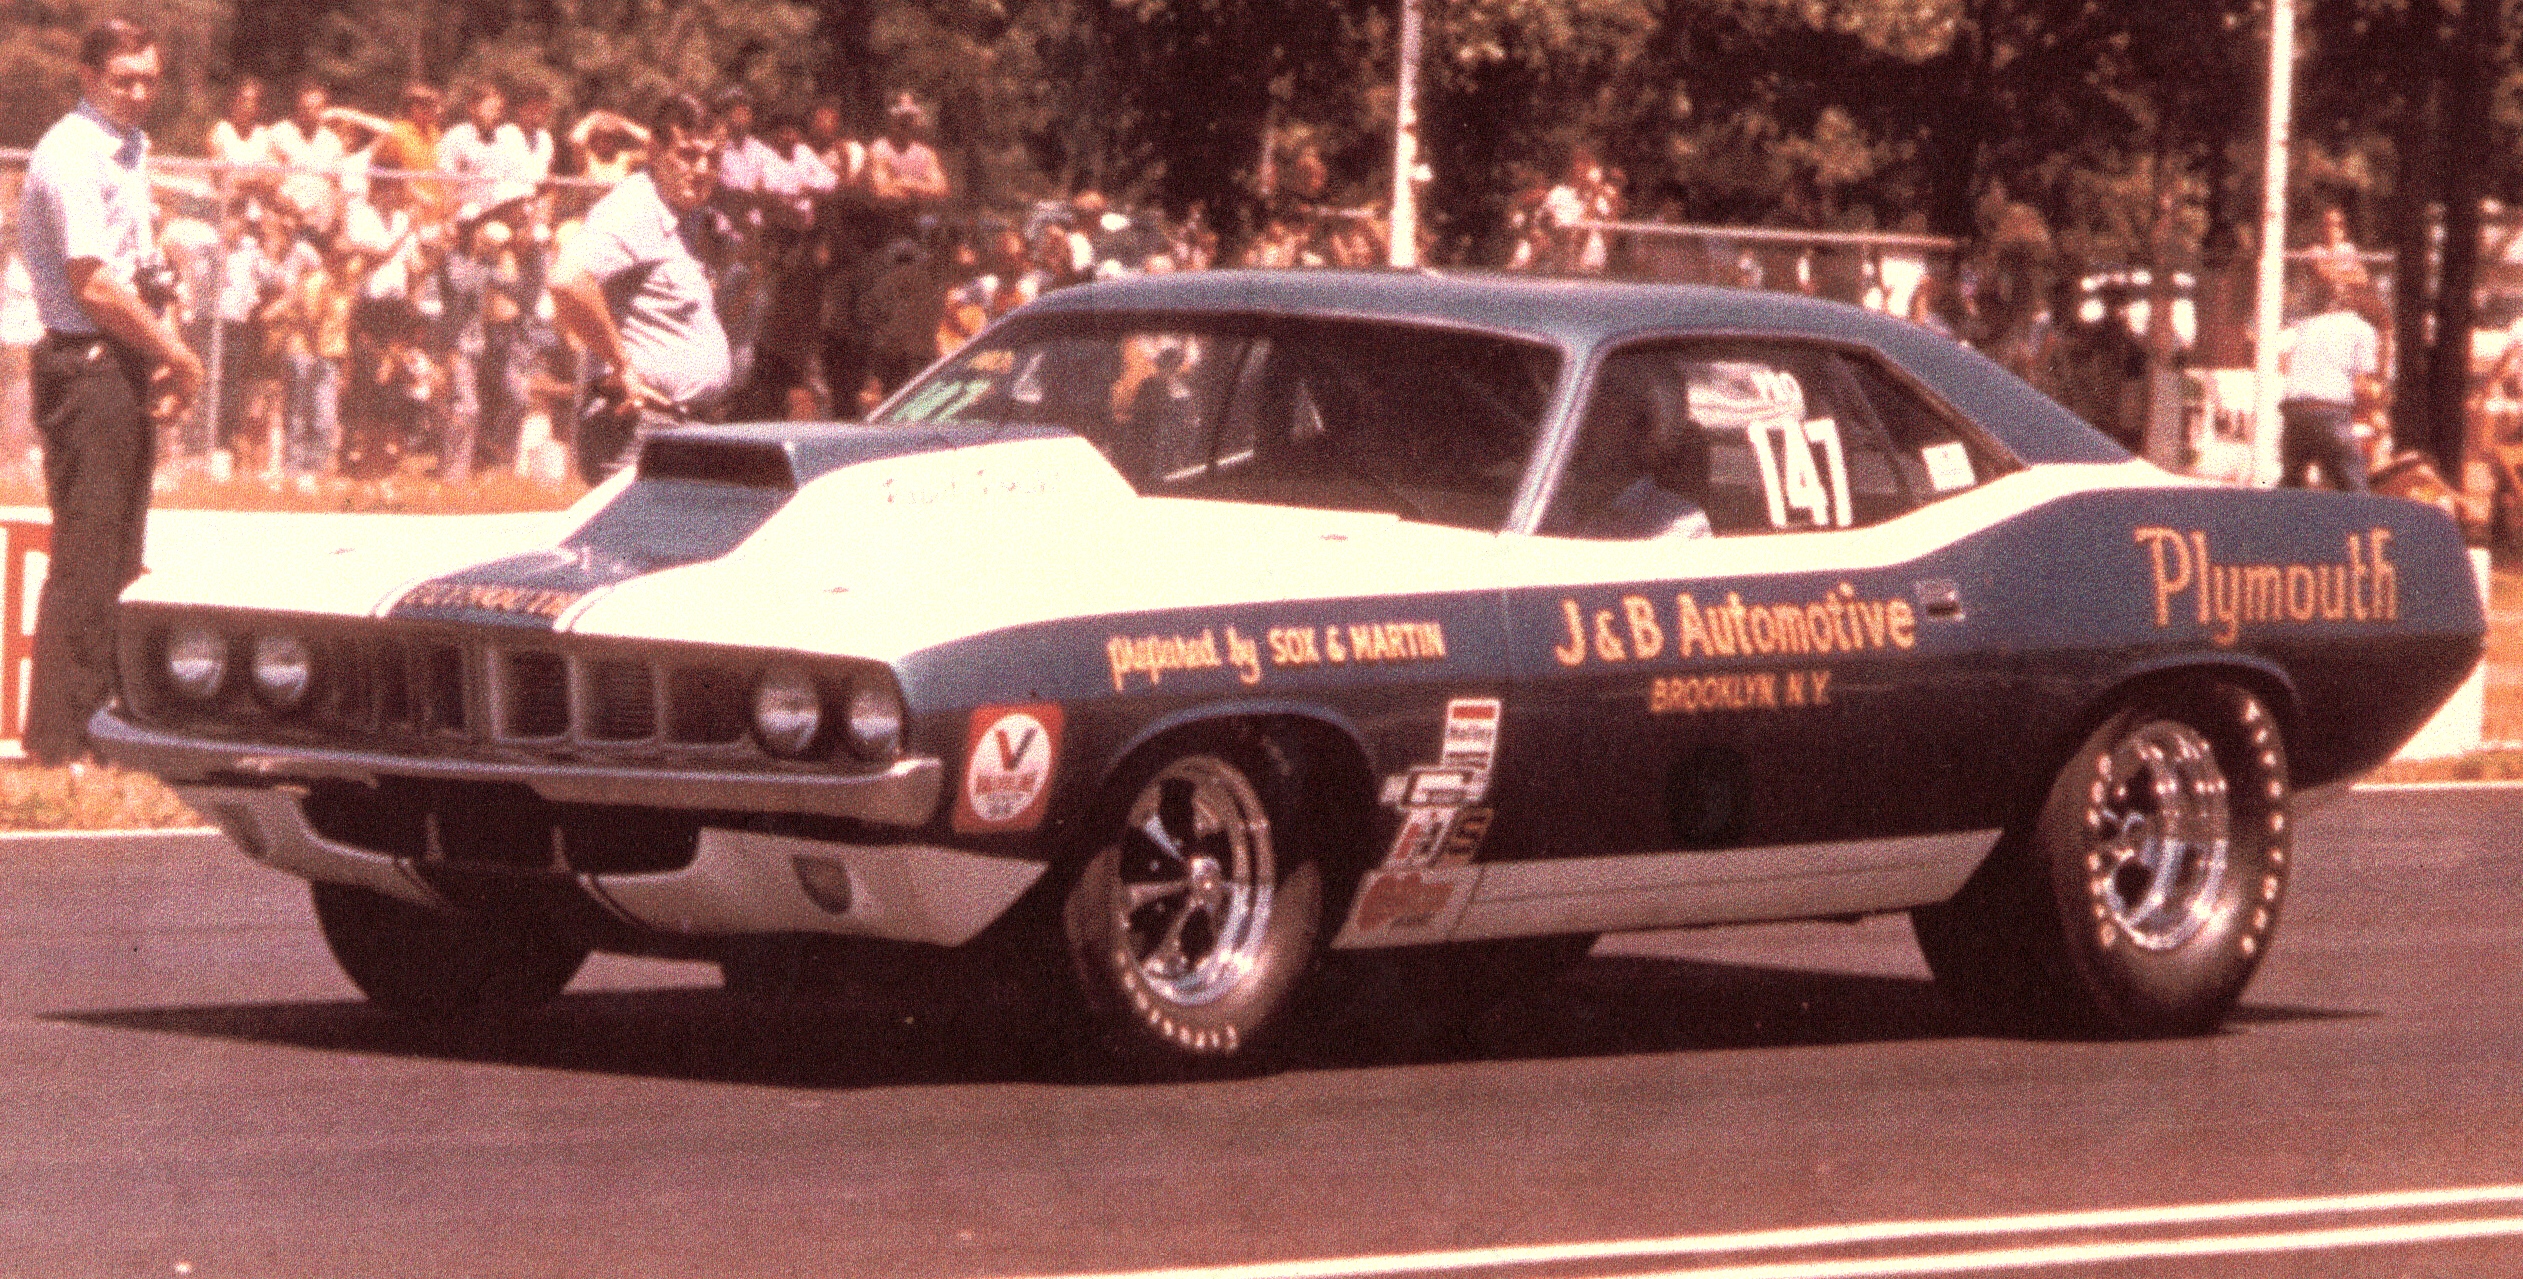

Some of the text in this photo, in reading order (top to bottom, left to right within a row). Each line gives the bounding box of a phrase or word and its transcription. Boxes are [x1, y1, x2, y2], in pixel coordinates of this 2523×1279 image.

[1748, 418, 1853, 528] 147
[1555, 582, 1916, 666] J & B Automotive
[2133, 526, 2397, 646] Plymouth
[1107, 622, 1447, 691] prepared by SOX & MARTIN
